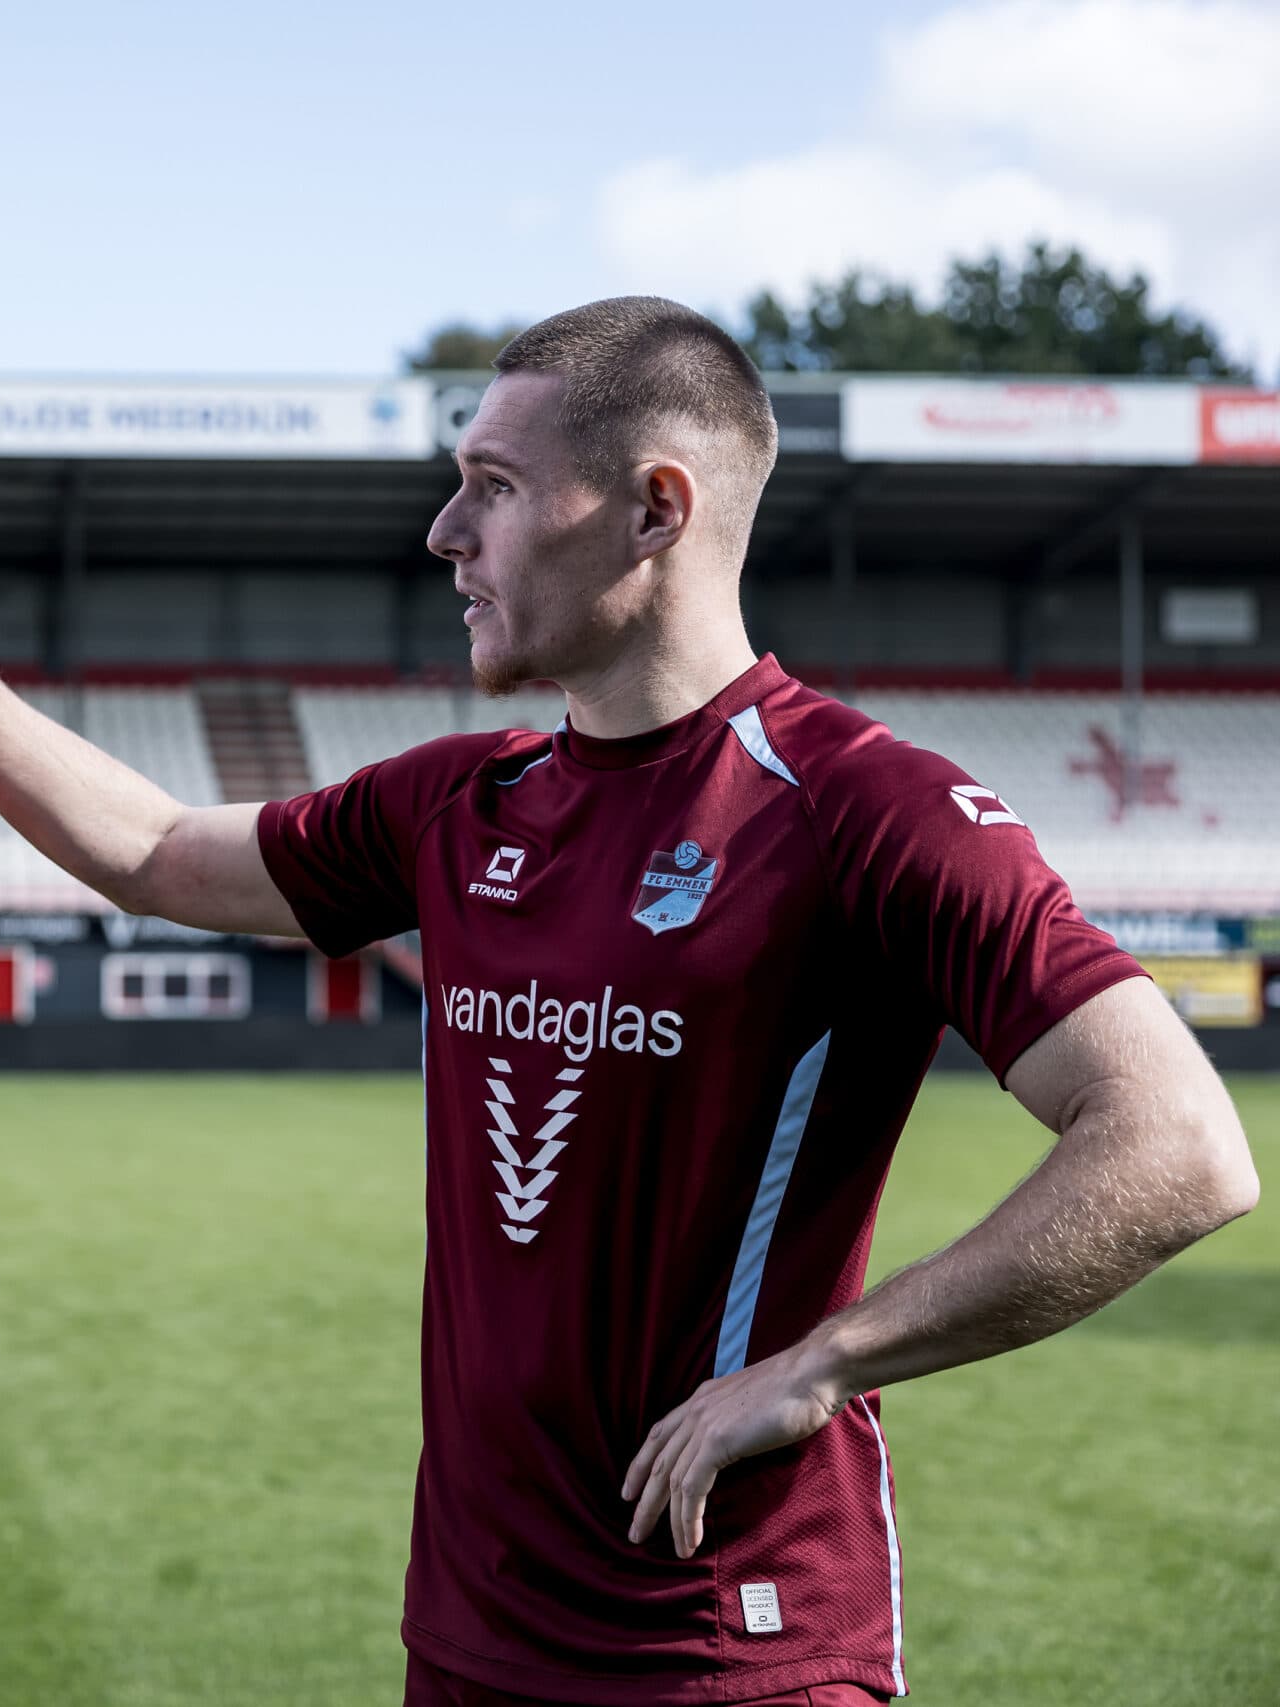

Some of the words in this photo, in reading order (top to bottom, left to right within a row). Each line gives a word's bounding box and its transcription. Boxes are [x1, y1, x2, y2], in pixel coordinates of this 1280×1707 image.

[467, 882, 518, 902] STANNO
[647, 875, 662, 885] FC
[665, 877, 708, 891] EMMEN
[441, 979, 684, 1062] vandaglas
